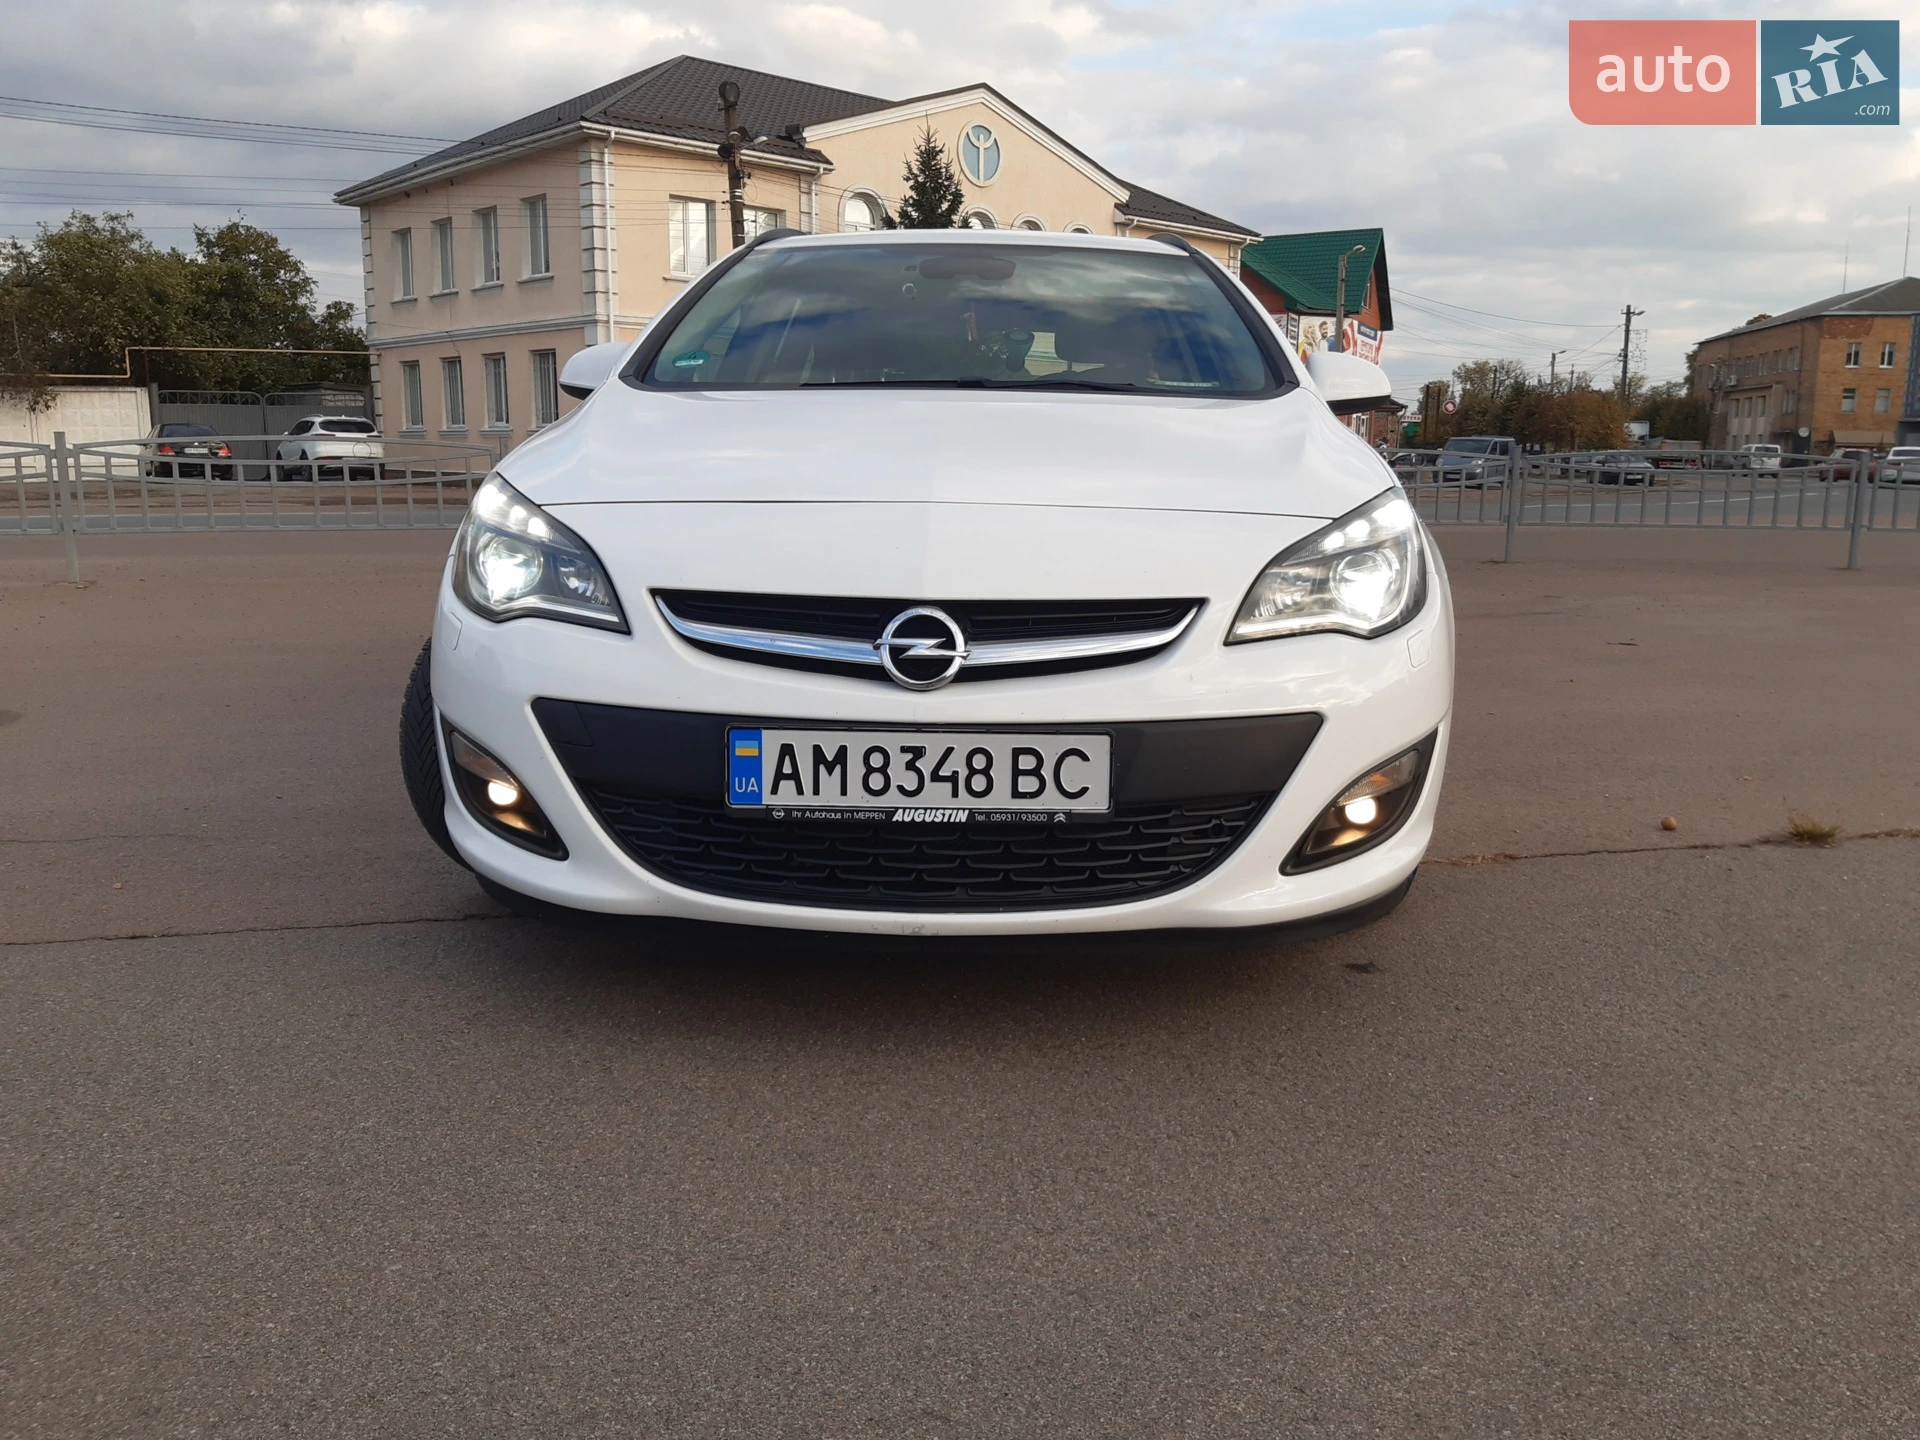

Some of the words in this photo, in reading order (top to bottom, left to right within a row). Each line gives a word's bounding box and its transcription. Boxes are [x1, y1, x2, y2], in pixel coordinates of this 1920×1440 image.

[770, 743, 848, 797] AM
[861, 745, 994, 799] 8348
[1011, 747, 1091, 800] BC
[735, 777, 759, 794] UA
[792, 810, 802, 818] Ihr
[805, 810, 842, 819] Autohaus
[853, 812, 886, 820] MEPPEN
[892, 808, 969, 822] AUGUSTIN
[975, 813, 988, 821] Tel.
[990, 813, 1048, 822] 05931/93500
